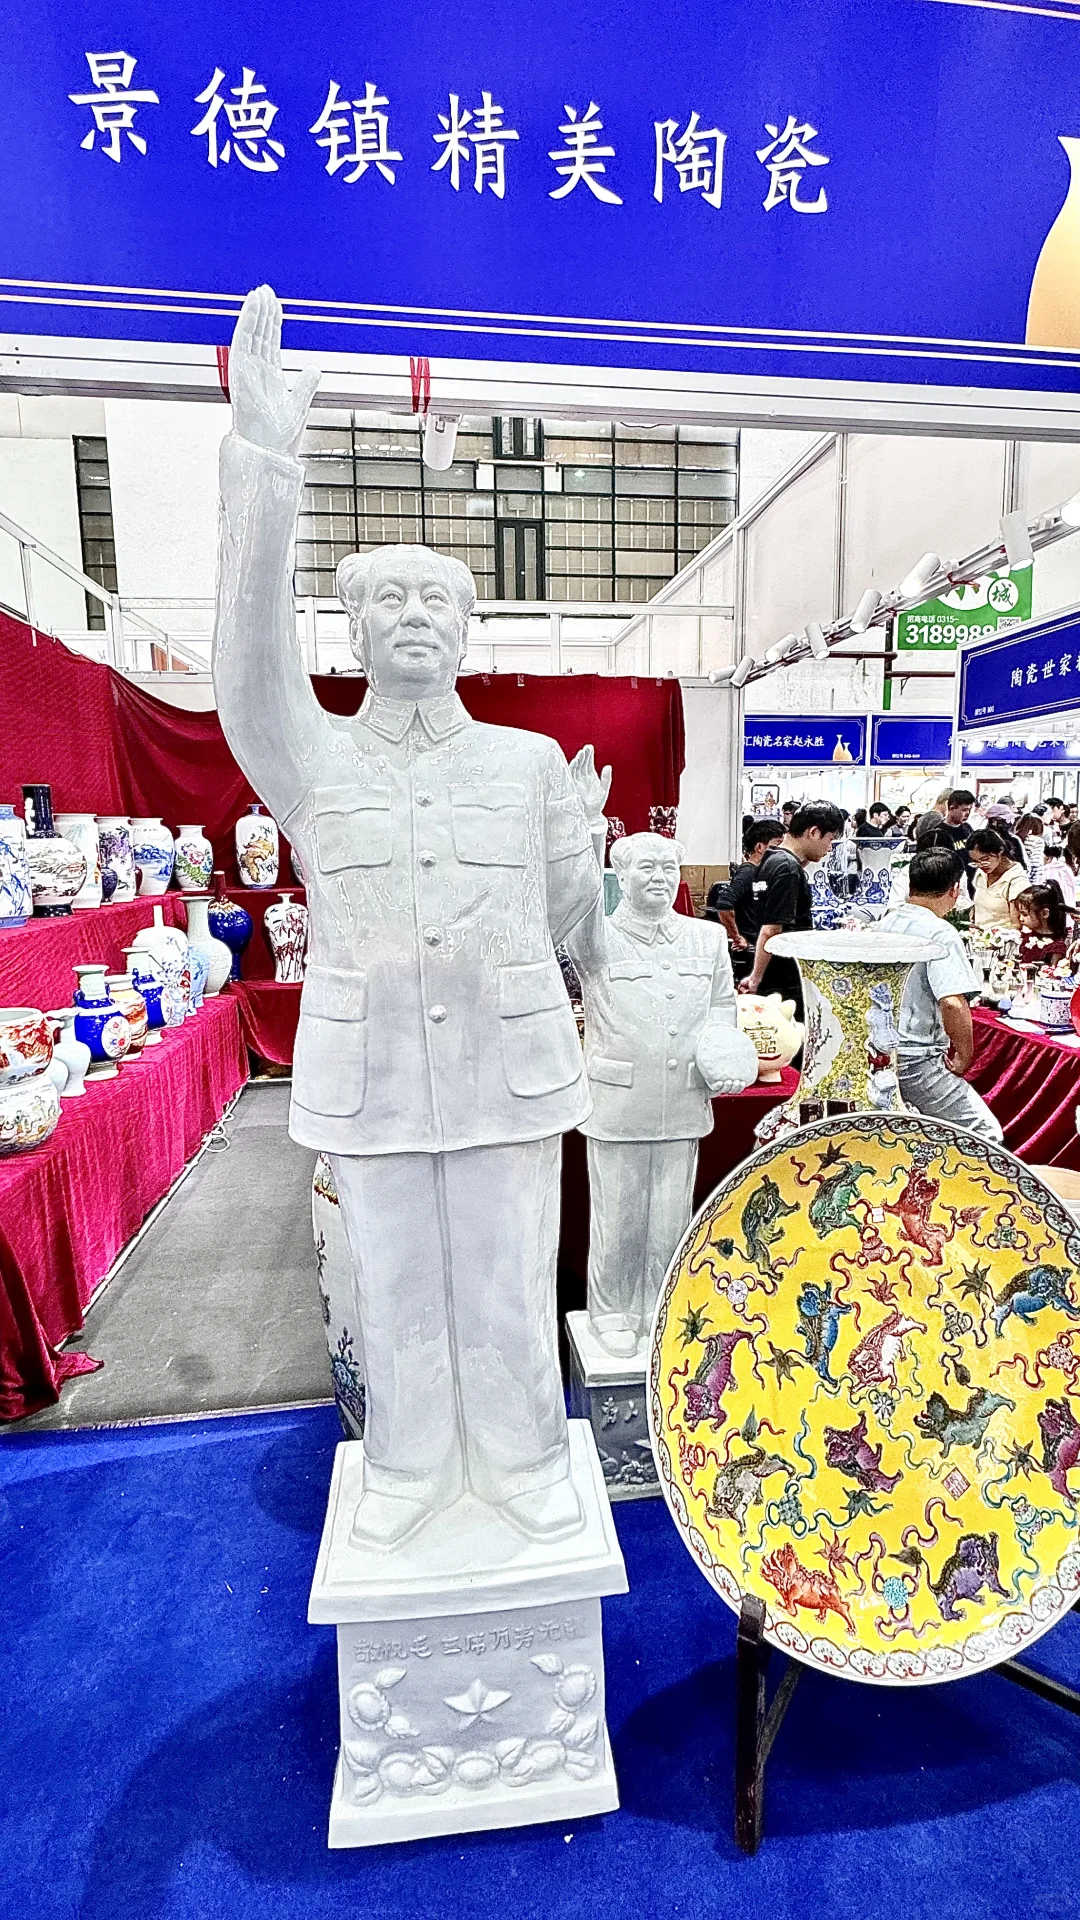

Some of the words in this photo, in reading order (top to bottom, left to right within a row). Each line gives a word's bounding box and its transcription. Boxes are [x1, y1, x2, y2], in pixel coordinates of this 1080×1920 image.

[68, 51, 832, 213] 景德镇精美陶瓷
